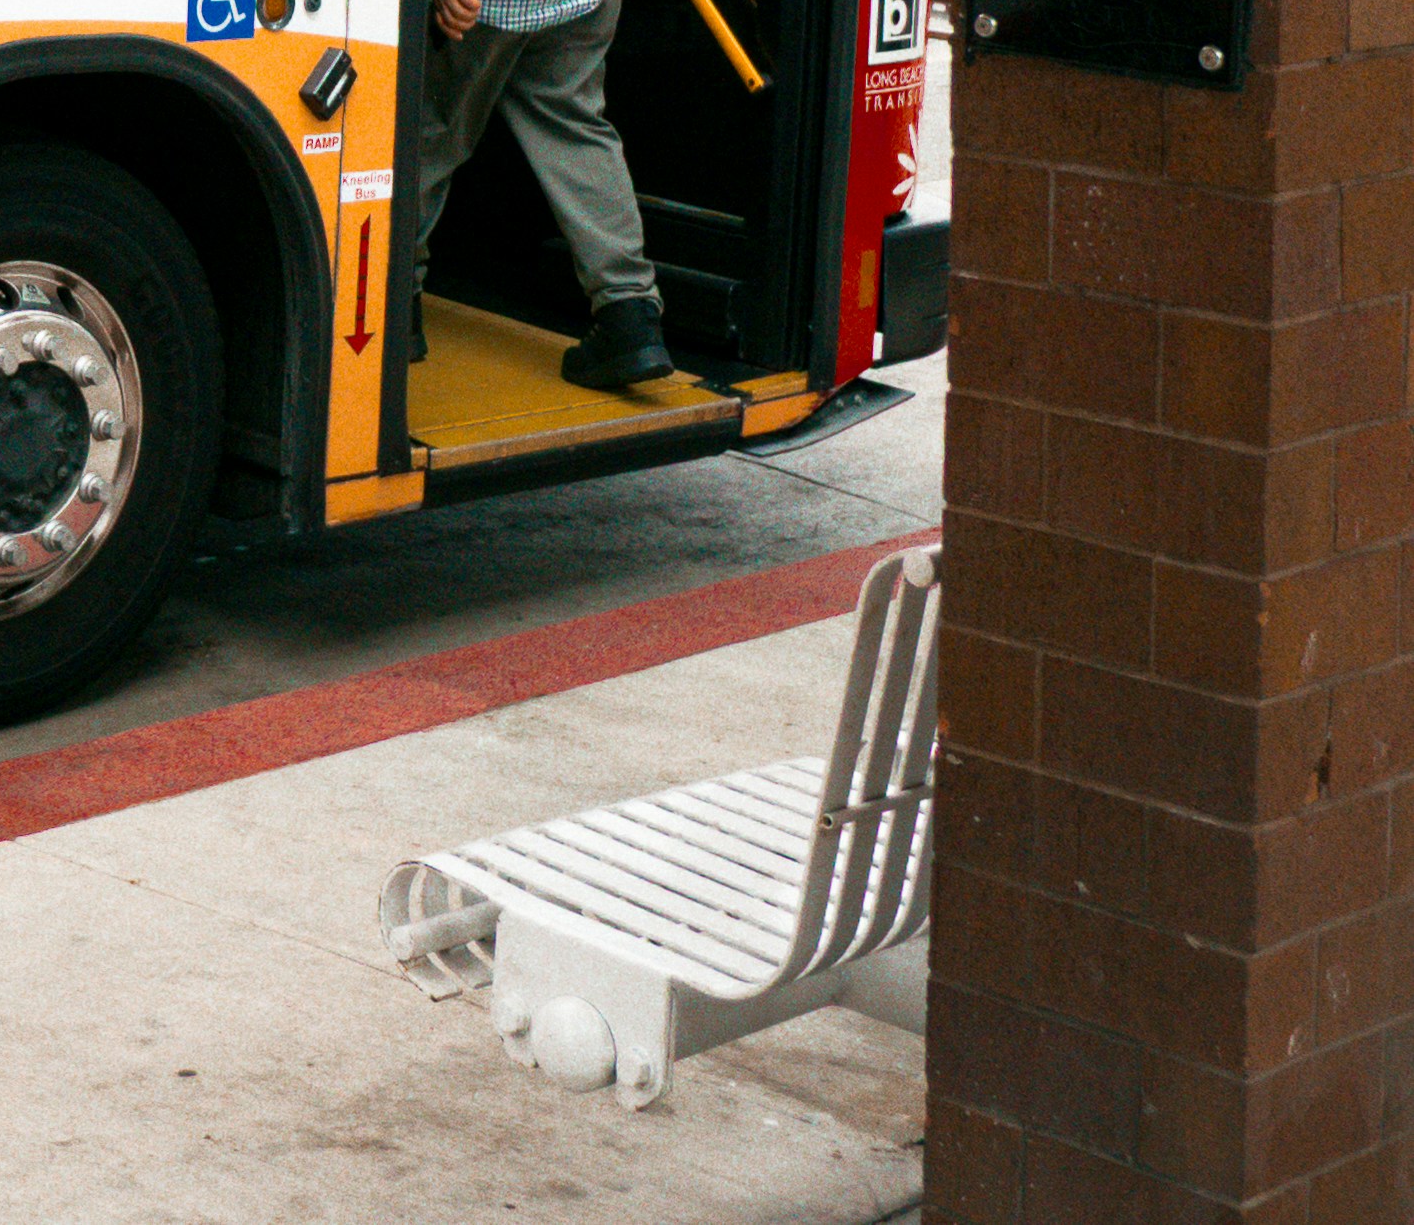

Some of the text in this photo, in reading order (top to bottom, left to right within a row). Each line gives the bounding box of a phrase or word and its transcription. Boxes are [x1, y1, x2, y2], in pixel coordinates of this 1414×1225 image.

[865, 69, 897, 89] LONG
[305, 136, 339, 150] RAMP
[342, 172, 391, 186] Kneeling
[355, 188, 377, 200] Bus
